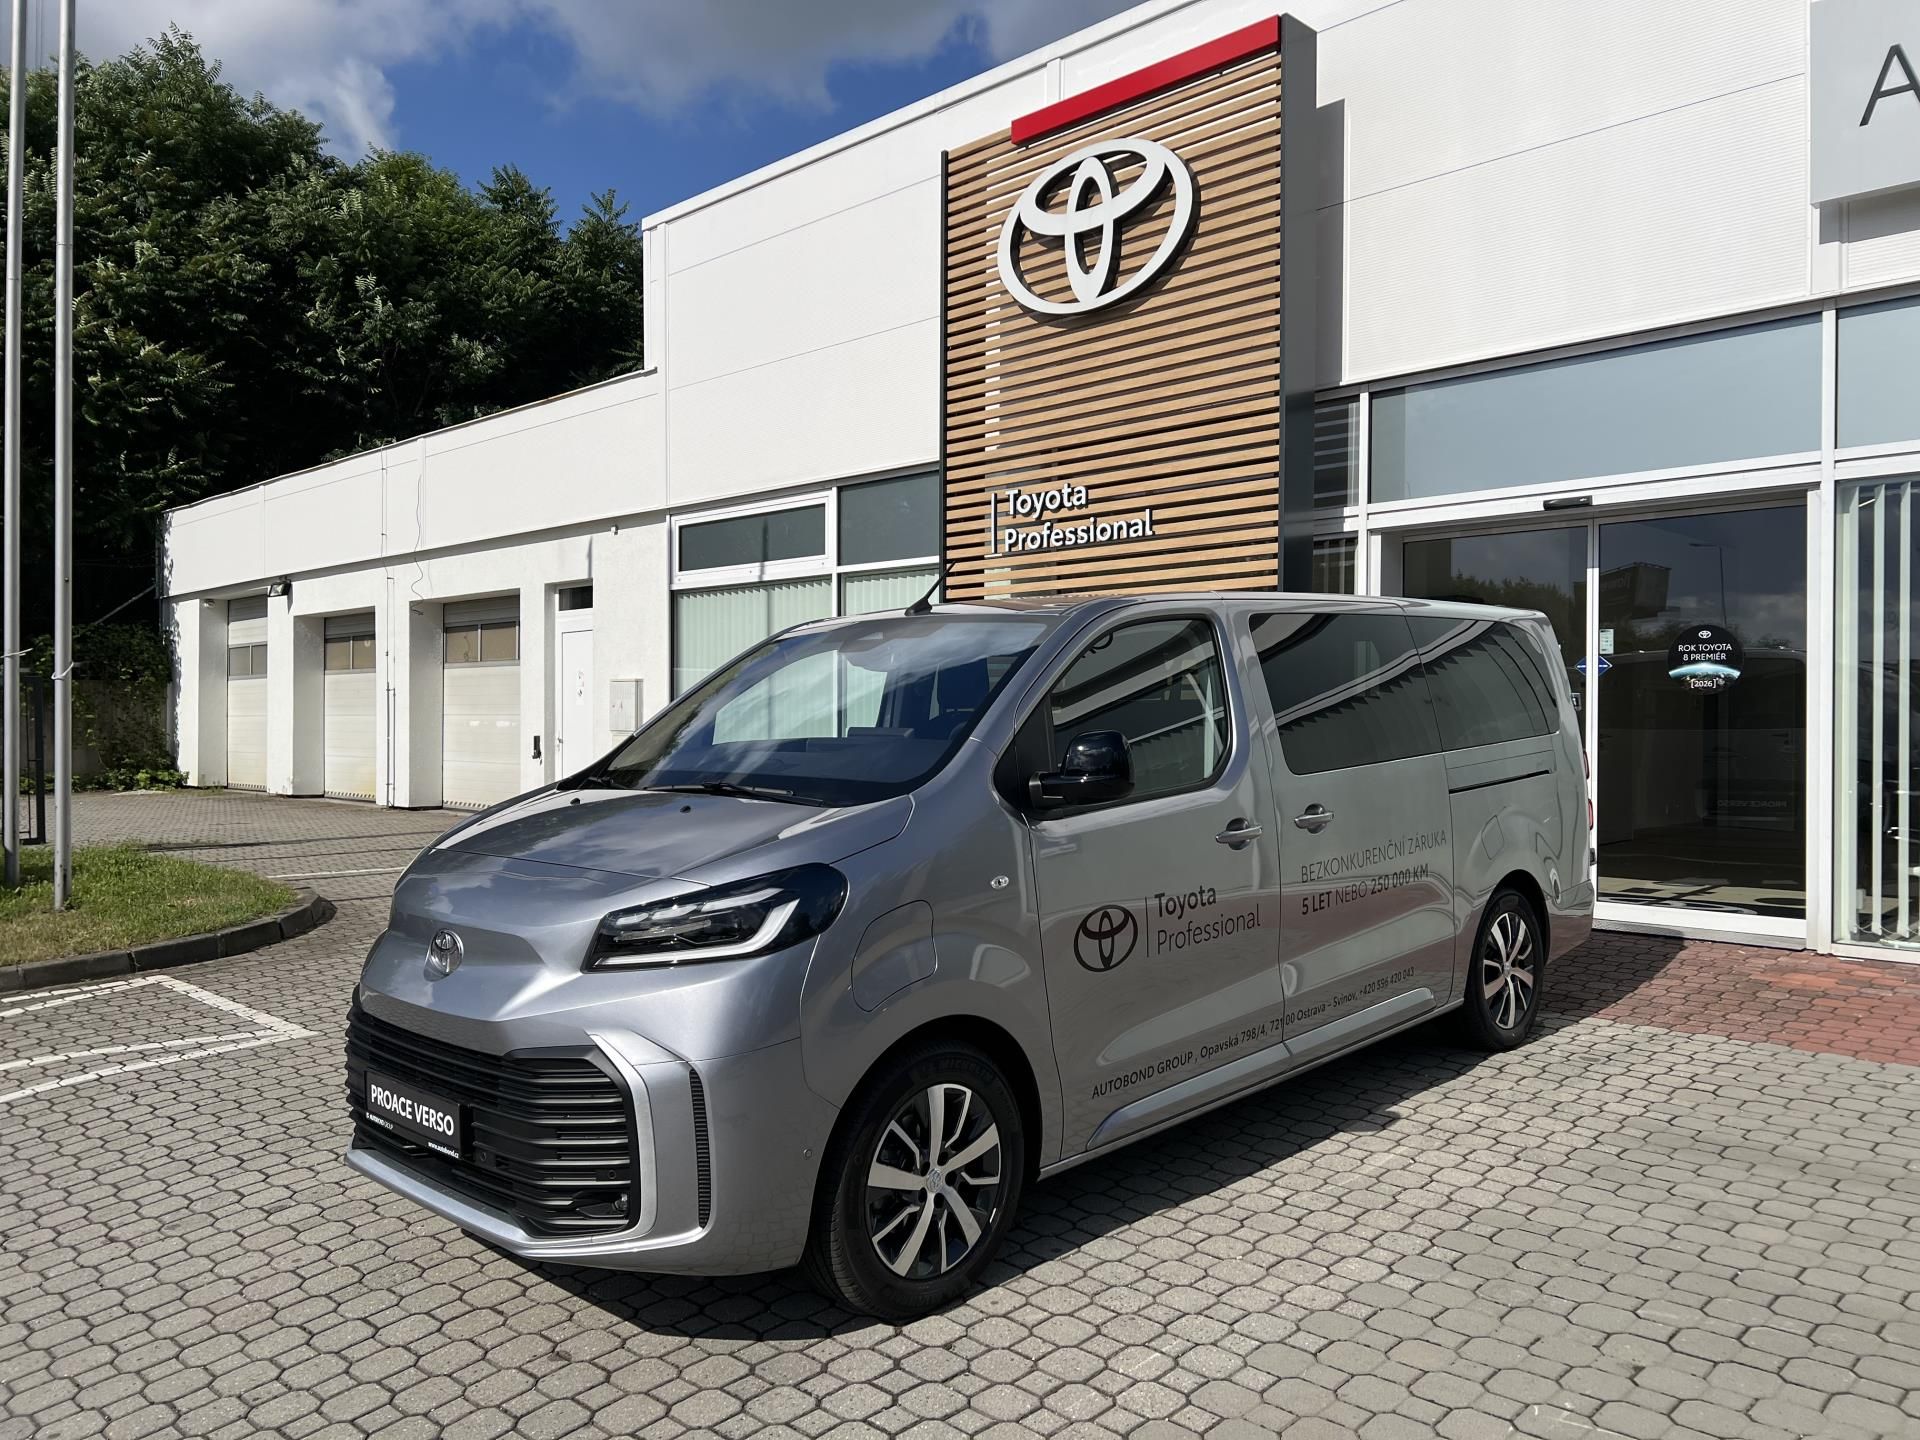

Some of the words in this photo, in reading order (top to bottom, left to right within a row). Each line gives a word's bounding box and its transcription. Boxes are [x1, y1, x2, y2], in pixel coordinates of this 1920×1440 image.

[1859, 43, 1920, 127] A
[1005, 483, 1087, 519] Toyota
[1004, 508, 1153, 552] Professional
[1678, 644, 1697, 652] ROK
[1698, 643, 1733, 651] TOYOTA
[1690, 651, 1727, 661] PREMIÉR
[1301, 836, 1405, 883] BEZKONKURENČNÍ
[1408, 830, 1447, 855] ZÁRUKA
[1154, 885, 1217, 920] Toyota
[1302, 897, 1309, 916] 5
[1312, 891, 1333, 913] LET
[1335, 881, 1368, 906] NEBO
[1370, 874, 1390, 896] 250
[1392, 868, 1411, 888] 000
[1413, 863, 1429, 882] KM
[1157, 903, 1261, 955] Professional
[1092, 1065, 1155, 1099] AUTOBOND
[1200, 1033, 1239, 1060] Opavská
[1297, 1003, 1326, 1021] Ostrava
[370, 1084, 413, 1120] PROACE
[414, 1102, 454, 1136] VERSO
